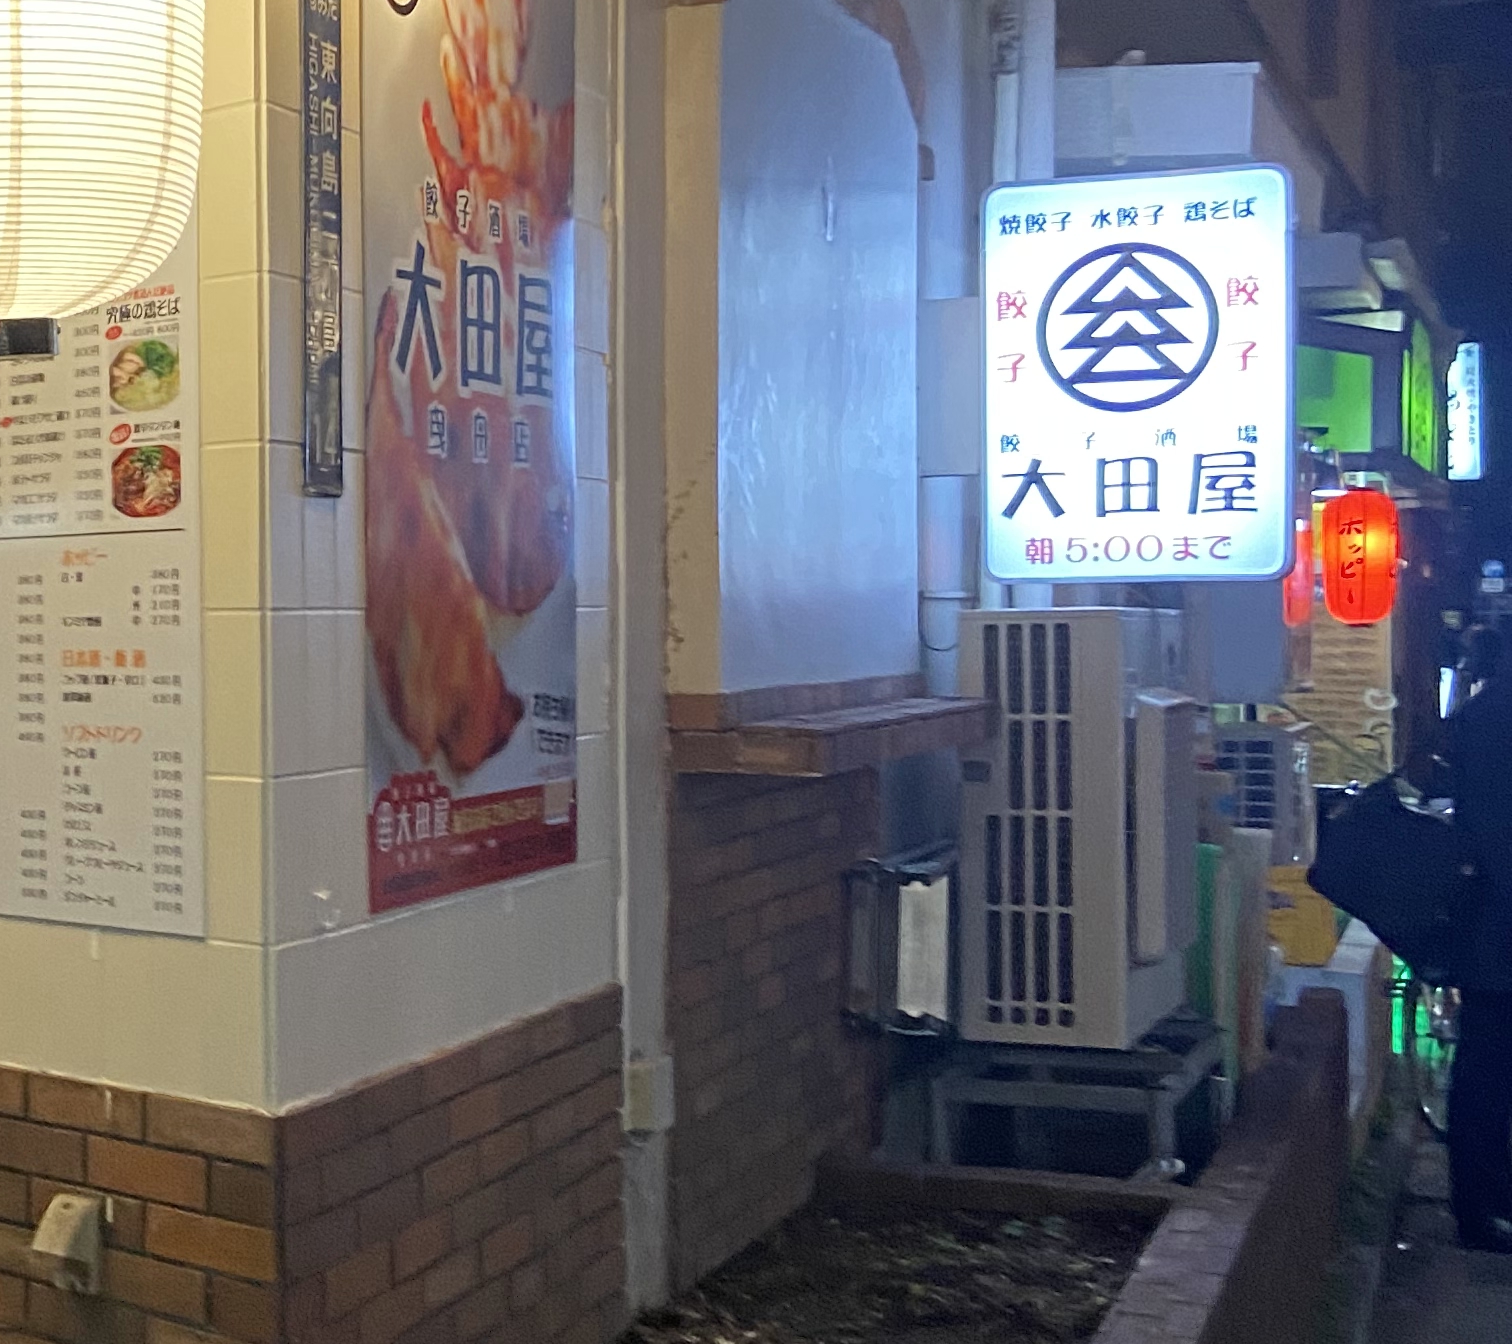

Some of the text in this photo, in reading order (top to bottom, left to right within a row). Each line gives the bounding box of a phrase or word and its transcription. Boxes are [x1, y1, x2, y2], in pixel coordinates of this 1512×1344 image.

[424, 179, 530, 248] 餃子酒場
[998, 196, 1258, 236] 焼餃子 水餃子 鶏そば
[394, 238, 553, 398] 大田屋
[995, 290, 1028, 383] 餃子
[1226, 275, 1259, 373] 餃子
[999, 424, 1258, 453] 餃子酒場
[1000, 450, 1259, 519] 大田屋
[1024, 533, 1232, 565] 朝5:00まで
[1338, 518, 1364, 604] ホッピー
